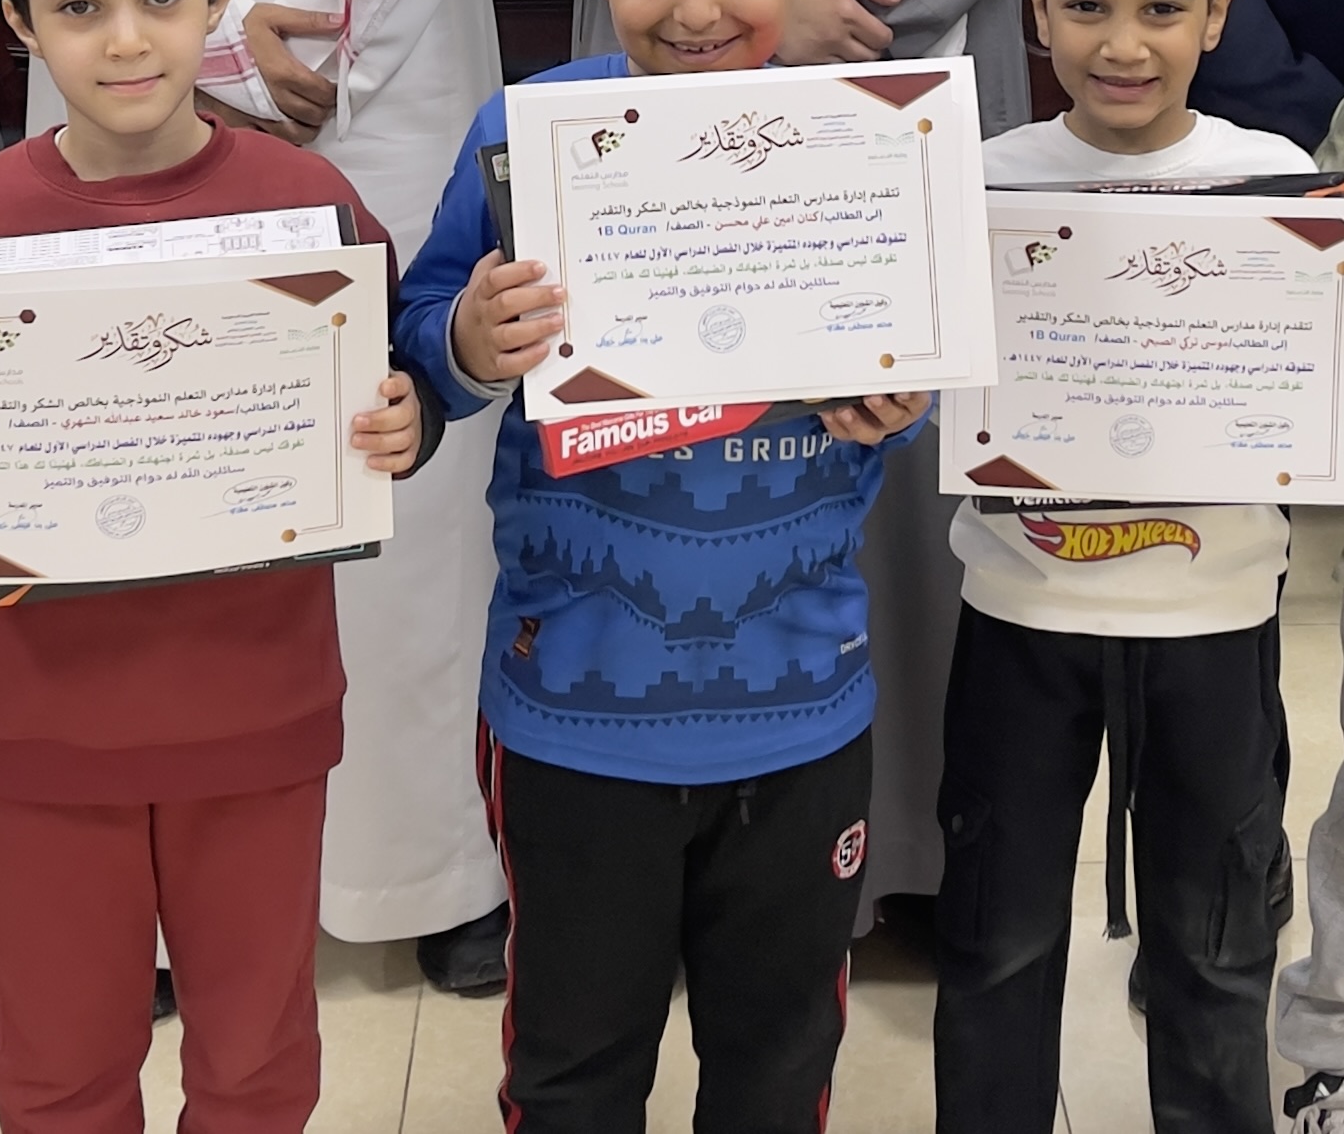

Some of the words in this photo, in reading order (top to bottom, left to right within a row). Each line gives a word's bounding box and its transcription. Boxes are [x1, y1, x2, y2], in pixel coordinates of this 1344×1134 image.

[741, 117, 803, 173] شكر
[710, 195, 766, 212] النموذجية
[768, 192, 800, 210] التعلم
[802, 191, 840, 208] مدارس
[842, 189, 866, 204] إدارة
[869, 186, 900, 204] تتقدم
[588, 203, 632, 221] والتقدير
[634, 200, 667, 218] الشكر
[669, 199, 709, 216] بخالص
[616, 223, 657, 236] Quran
[1165, 248, 1227, 297] شكر
[1015, 310, 1058, 326] والتقدير
[1058, 311, 1091, 327] الشكر
[1092, 315, 1130, 330] بخالص
[1132, 315, 1186, 332] النموذجية
[1187, 318, 1218, 333] التعلم
[1220, 320, 1256, 334] مدارس
[1258, 320, 1281, 334] إدارة
[1282, 320, 1313, 335] تتقدم
[1047, 329, 1086, 343] Quran
[144, 318, 212, 372] شكر
[209, 386, 249, 402] مدارس
[251, 382, 276, 397] إدارة
[278, 376, 311, 396] تتقدم
[30, 396, 64, 414] الشكر
[67, 396, 109, 412] بخالص
[111, 391, 171, 409] النموذجية
[173, 389, 207, 406] التعلم
[561, 412, 670, 460] Famous
[678, 406, 724, 428] Car
[723, 432, 834, 463] GROUP
